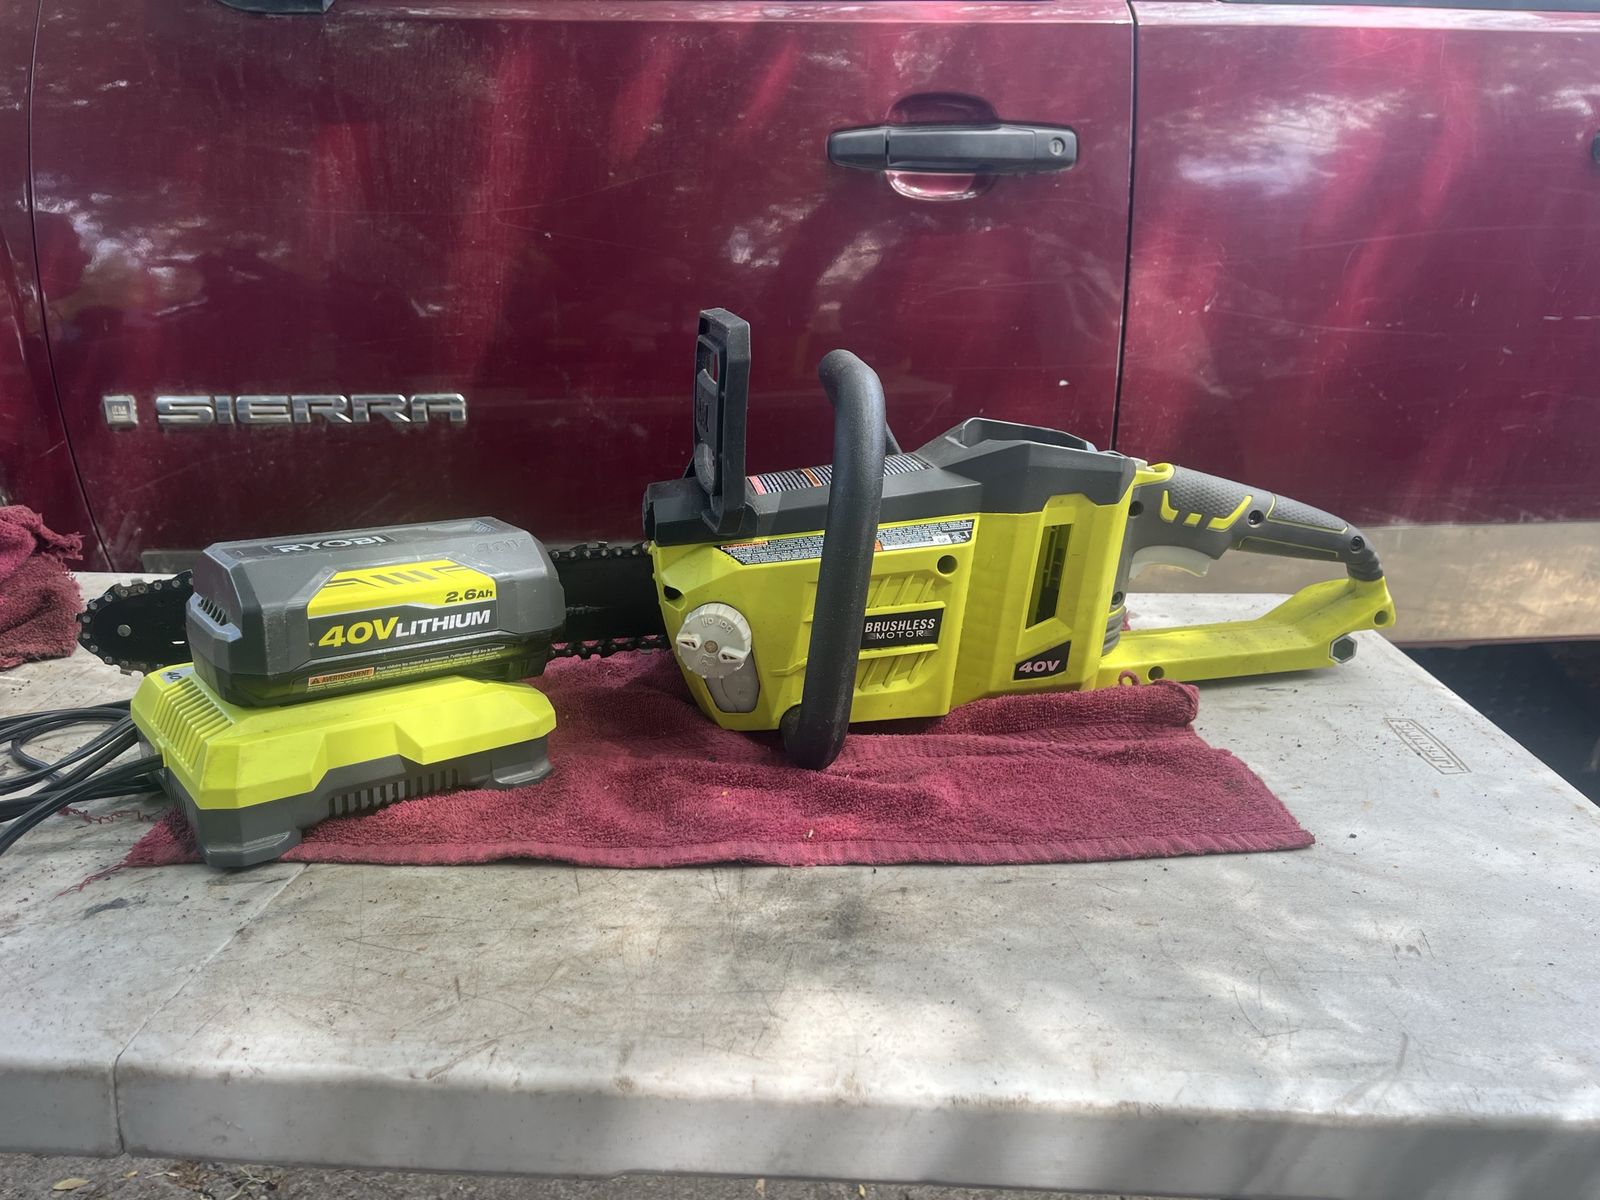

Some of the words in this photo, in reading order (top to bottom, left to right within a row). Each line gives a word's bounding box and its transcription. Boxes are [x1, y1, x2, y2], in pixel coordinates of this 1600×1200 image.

[156, 394, 467, 424] SIERRA
[273, 536, 386, 553] RYOBI
[445, 588, 493, 603] 2.6Ah
[318, 616, 399, 648] 40V
[395, 609, 491, 638] LITHIUM
[865, 618, 936, 633] BRUSHLESS
[876, 630, 924, 640] MOTOR
[1019, 660, 1060, 673] 40V
